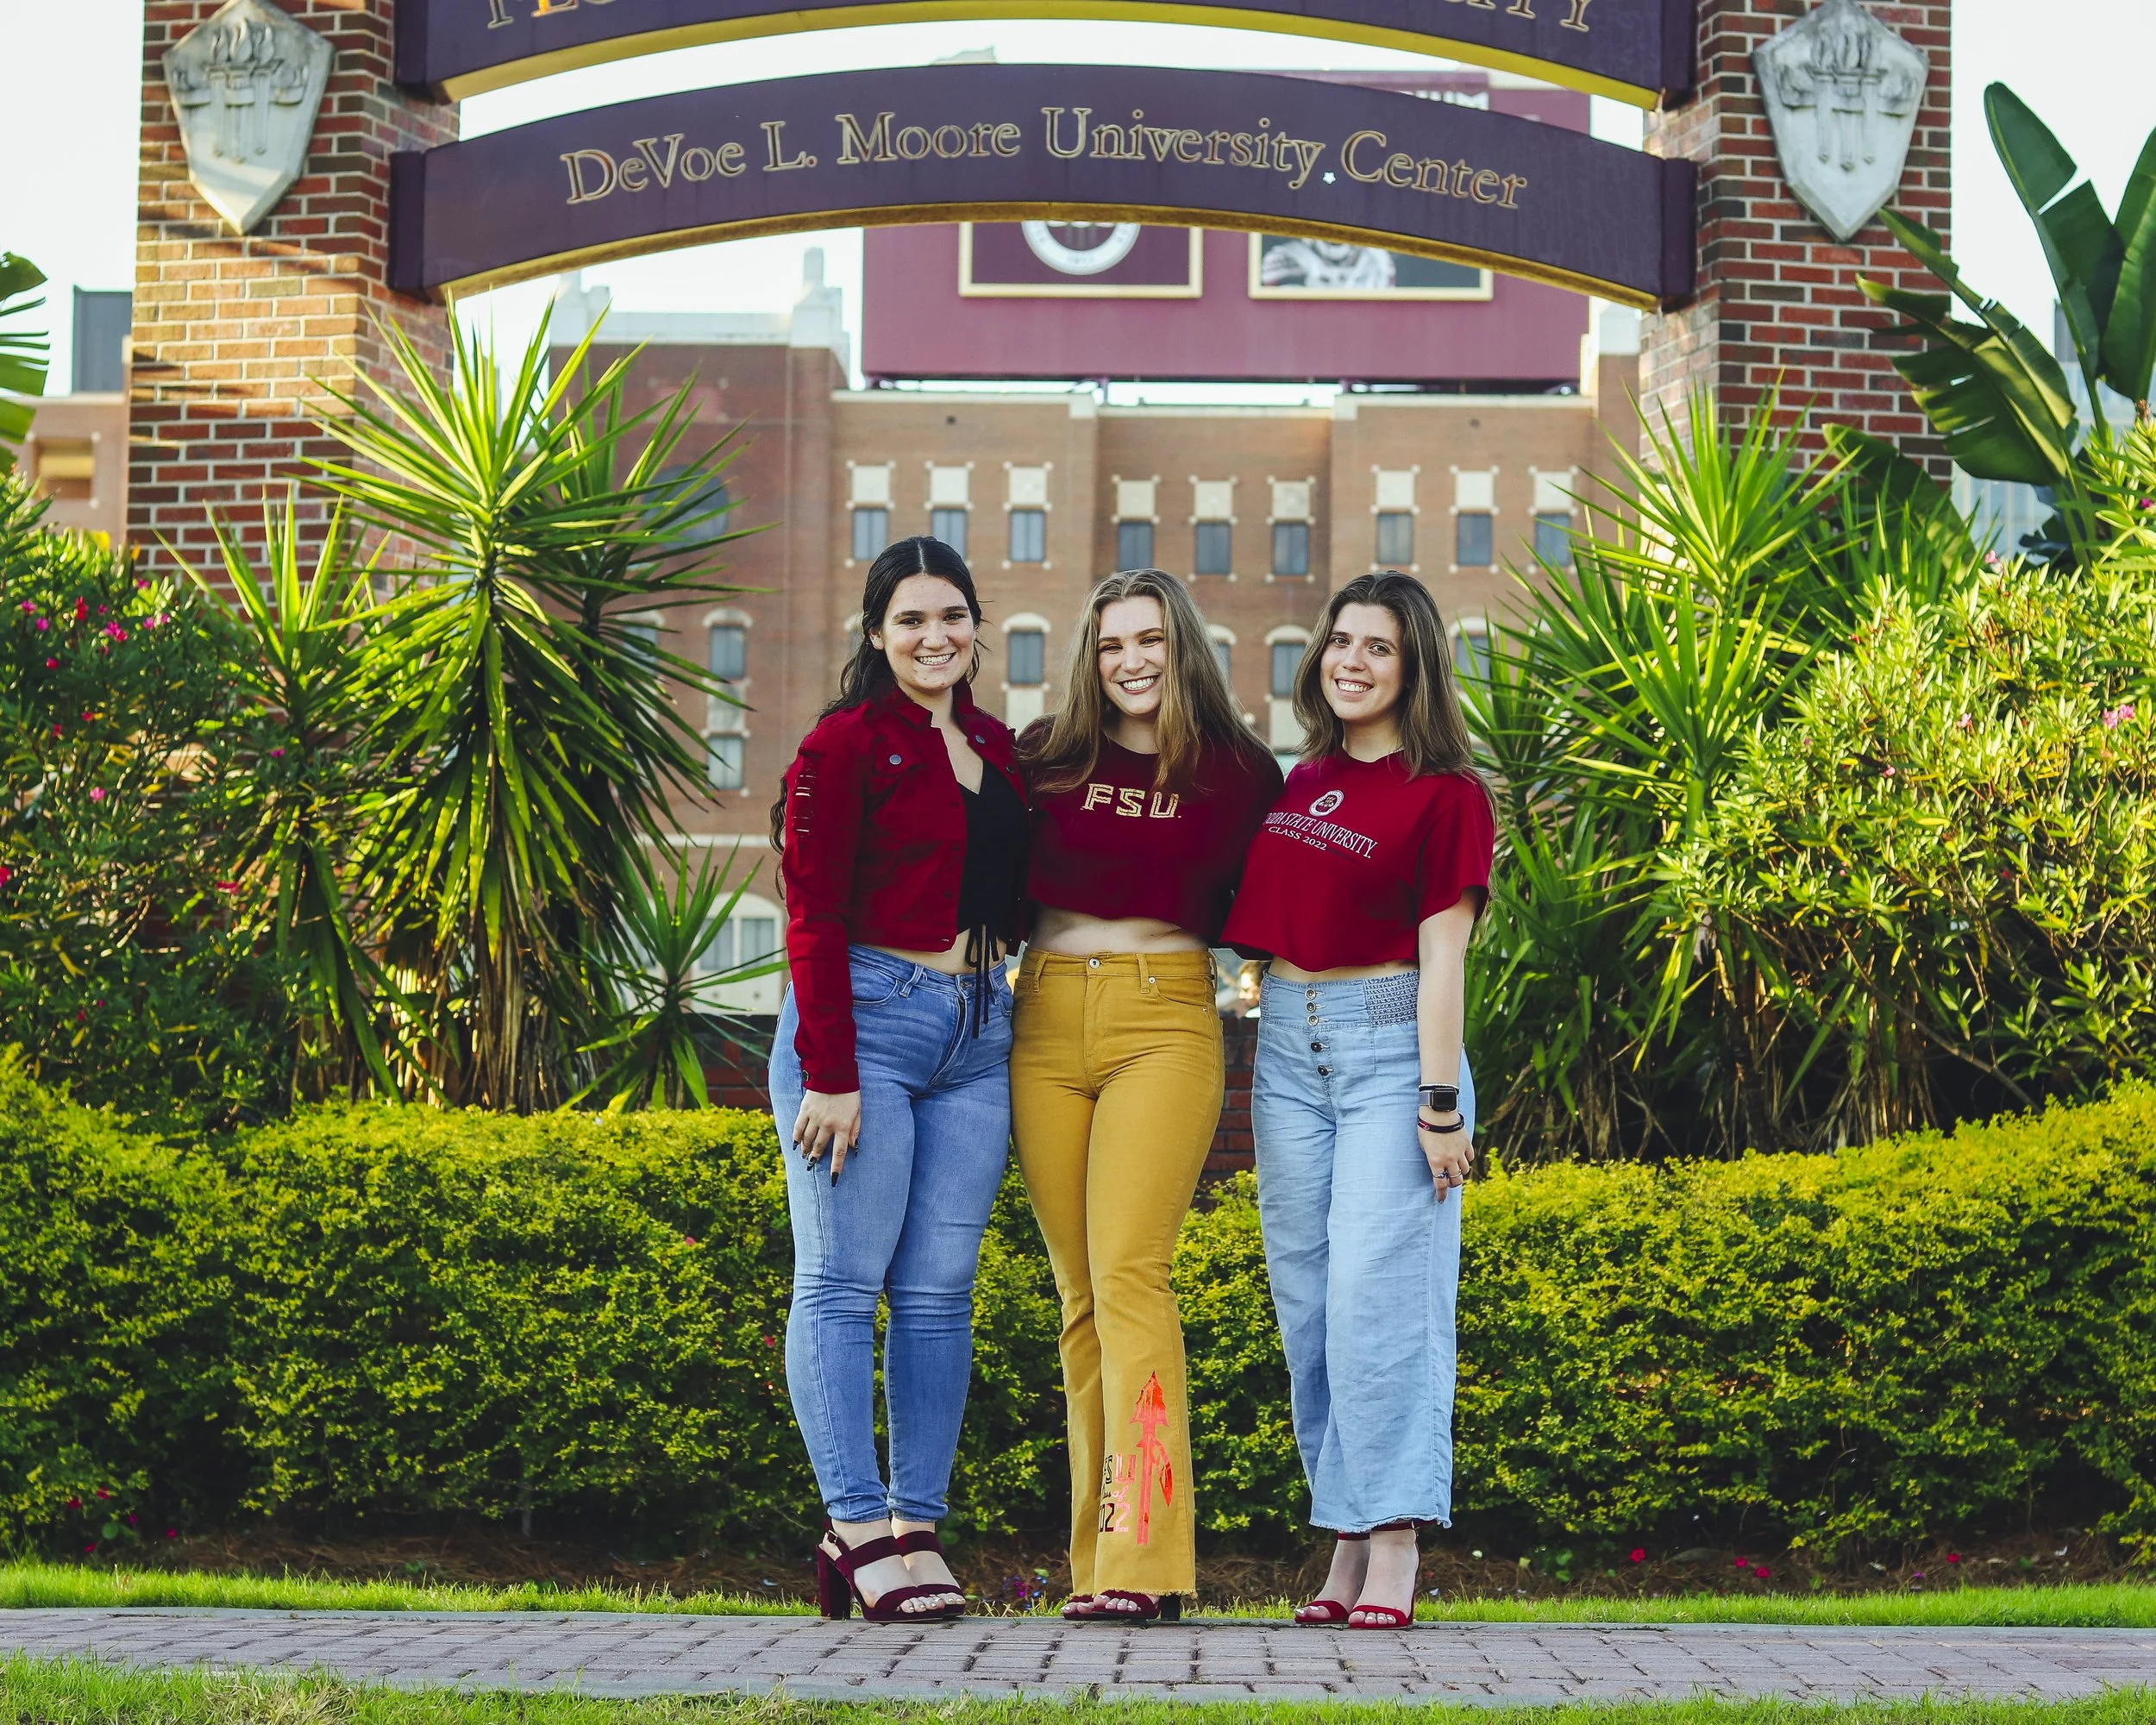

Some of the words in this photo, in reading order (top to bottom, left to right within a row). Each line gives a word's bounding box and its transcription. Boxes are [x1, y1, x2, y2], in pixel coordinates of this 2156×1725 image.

[560, 133, 746, 205] DeVoe
[760, 121, 818, 172] L.
[835, 111, 1021, 166] Moore
[1041, 107, 1326, 190] University
[1340, 129, 1527, 209] Center
[1281, 812, 1317, 832] STATE
[1268, 825, 1301, 840] CLASS
[1302, 836, 1327, 850] 2022
